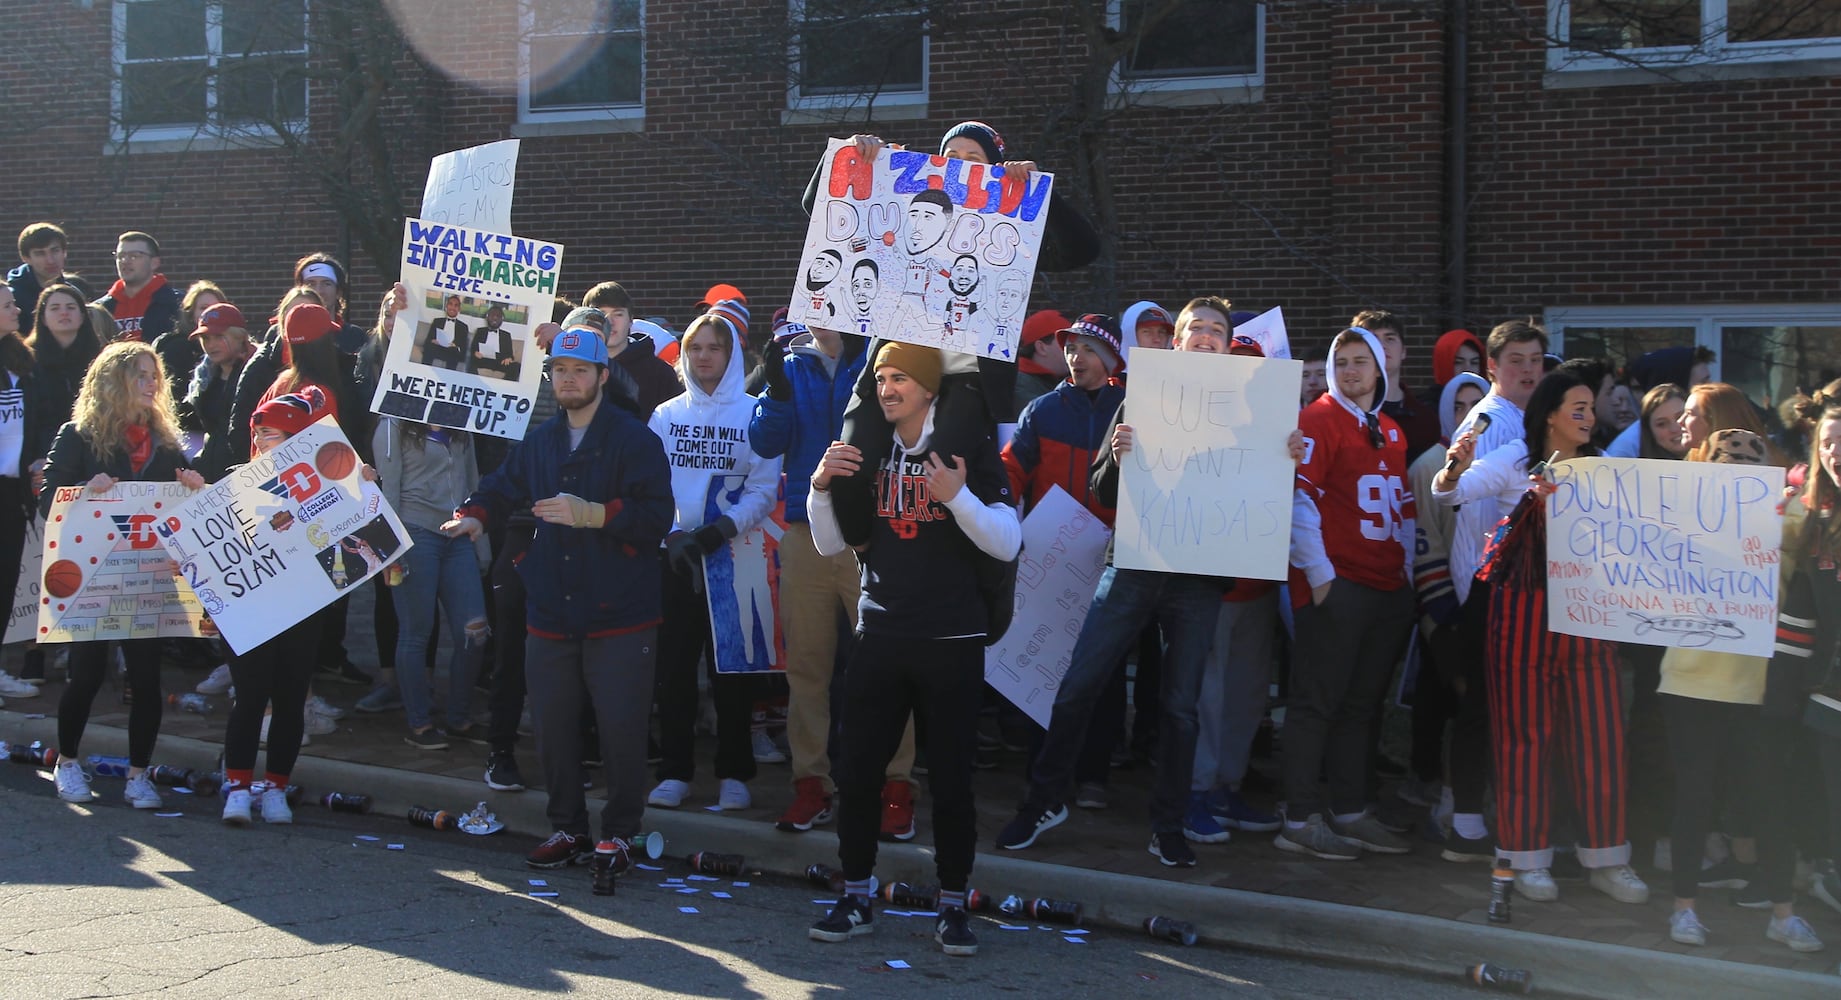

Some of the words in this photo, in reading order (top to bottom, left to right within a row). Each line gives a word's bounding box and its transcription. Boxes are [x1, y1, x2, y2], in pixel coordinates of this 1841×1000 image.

[829, 145, 874, 201] A
[473, 195, 498, 224] MY
[410, 221, 556, 271] WALKING
[407, 242, 467, 276] INTO
[469, 256, 555, 294] MARCH
[954, 312, 963, 323] 3
[449, 384, 497, 410] HERE
[501, 393, 531, 415] TO
[1160, 379, 1237, 433] WE
[669, 422, 690, 438] THE
[692, 425, 716, 440] SUN
[718, 427, 746, 443] WILL
[676, 440, 707, 455] COME
[711, 441, 735, 456] OUT
[669, 453, 737, 470] TOMORROW
[1135, 445, 1257, 478] WANT
[129, 483, 156, 498] OUR
[184, 479, 241, 520] WHERE
[306, 492, 336, 512] COLLEGE
[309, 496, 340, 518] GAMEDAY
[1549, 464, 1680, 526] BUCKLE
[1696, 475, 1769, 540] UP
[191, 500, 253, 549] LOVE
[1137, 488, 1280, 553] KANSAS
[1357, 473, 1403, 543] 99
[156, 516, 182, 539] UD
[744, 535, 751, 546] 1
[1568, 516, 1704, 570] GEORGE
[208, 524, 270, 574] LOVE
[223, 548, 287, 599] SLAM
[1602, 561, 1775, 601] WASHINGTON
[112, 598, 133, 612] VCU
[1056, 588, 1080, 611] is
[1565, 586, 1589, 602] ITS
[1592, 588, 1665, 611] GONNA
[1672, 599, 1697, 615] BE
[1706, 599, 1719, 616] A
[1724, 601, 1778, 624] BUMPY
[1566, 602, 1618, 628] RIDE
